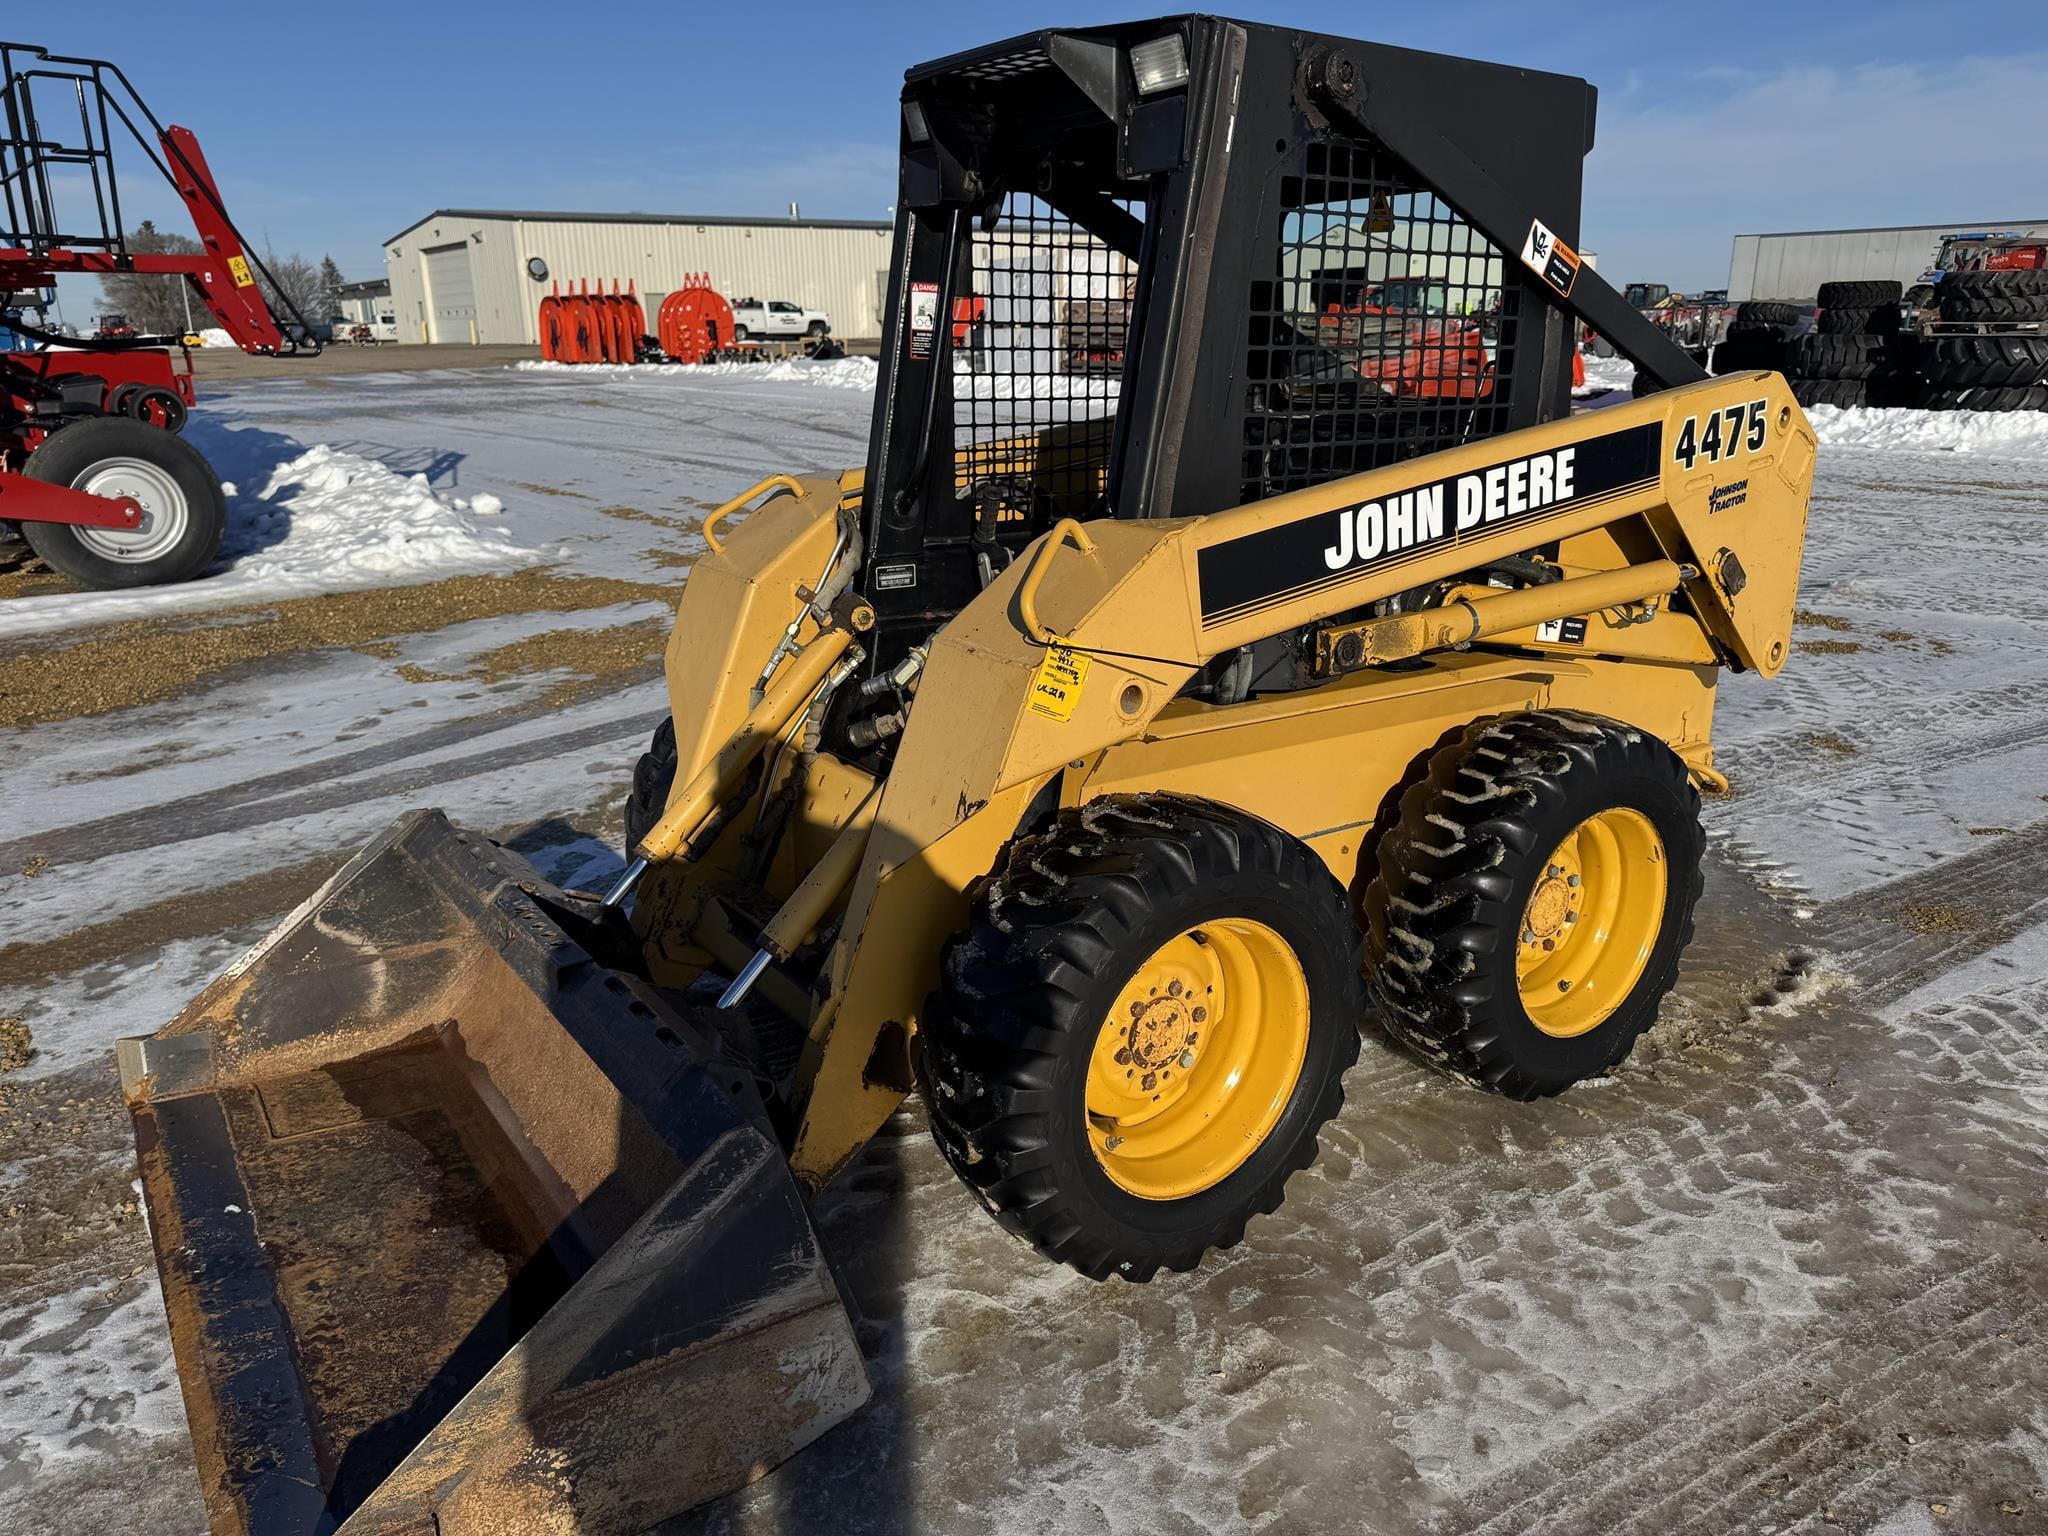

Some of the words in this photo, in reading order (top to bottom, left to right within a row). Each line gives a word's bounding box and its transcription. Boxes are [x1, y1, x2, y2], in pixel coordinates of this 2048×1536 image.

[918, 283, 939, 292] DANGE
[1673, 397, 1769, 472] 4475
[1324, 483, 1444, 570] JOHN
[1456, 447, 1576, 531] DEERE
